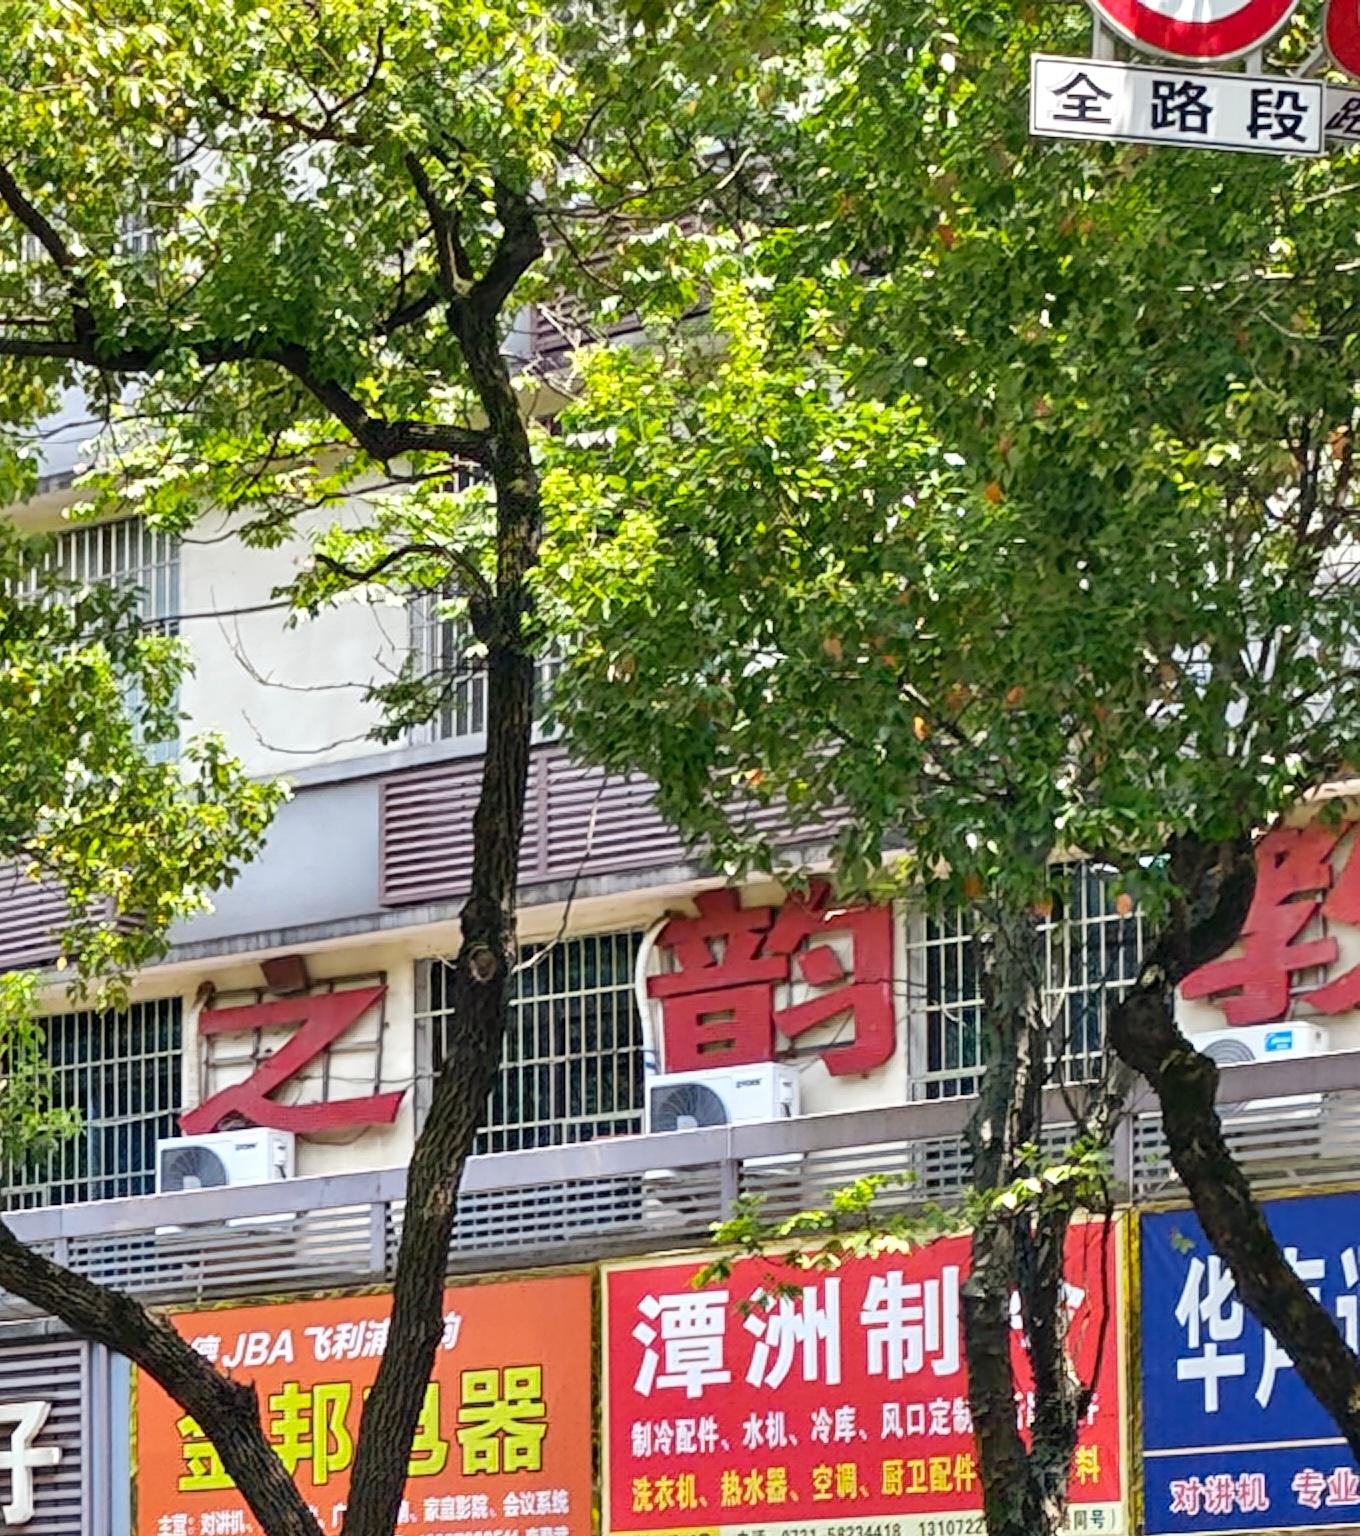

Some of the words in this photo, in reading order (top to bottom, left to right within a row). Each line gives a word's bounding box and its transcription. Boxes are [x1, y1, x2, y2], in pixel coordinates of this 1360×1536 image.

[1051, 72, 1308, 143] 全路段
[647, 882, 895, 1077] 韵
[222, 1329, 294, 1368] JBA
[1169, 1472, 1270, 1515] 对讲机
[1291, 1466, 1360, 1508] 专业
